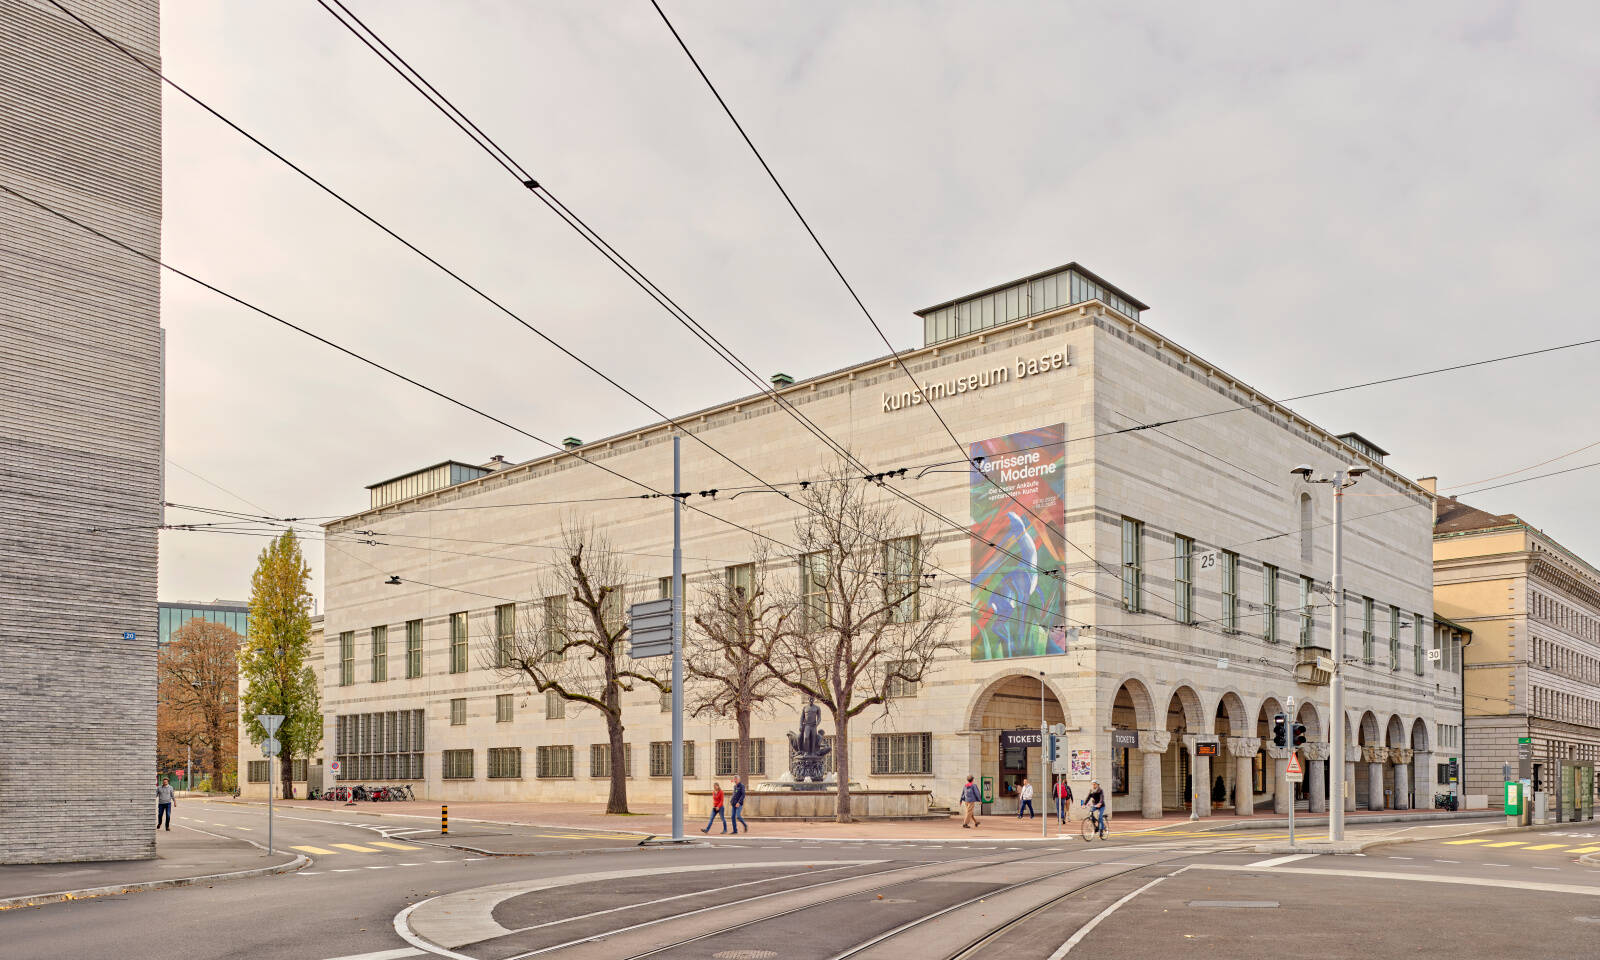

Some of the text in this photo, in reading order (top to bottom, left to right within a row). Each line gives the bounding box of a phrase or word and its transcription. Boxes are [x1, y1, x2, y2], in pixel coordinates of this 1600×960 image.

[881, 344, 1071, 412] kunstmuseum basel
[1000, 462, 1056, 482] Moderne
[1201, 553, 1215, 569] 25
[1429, 651, 1439, 659] 30
[1007, 734, 1042, 744] TICKETS
[1115, 735, 1136, 744] TICKETS
